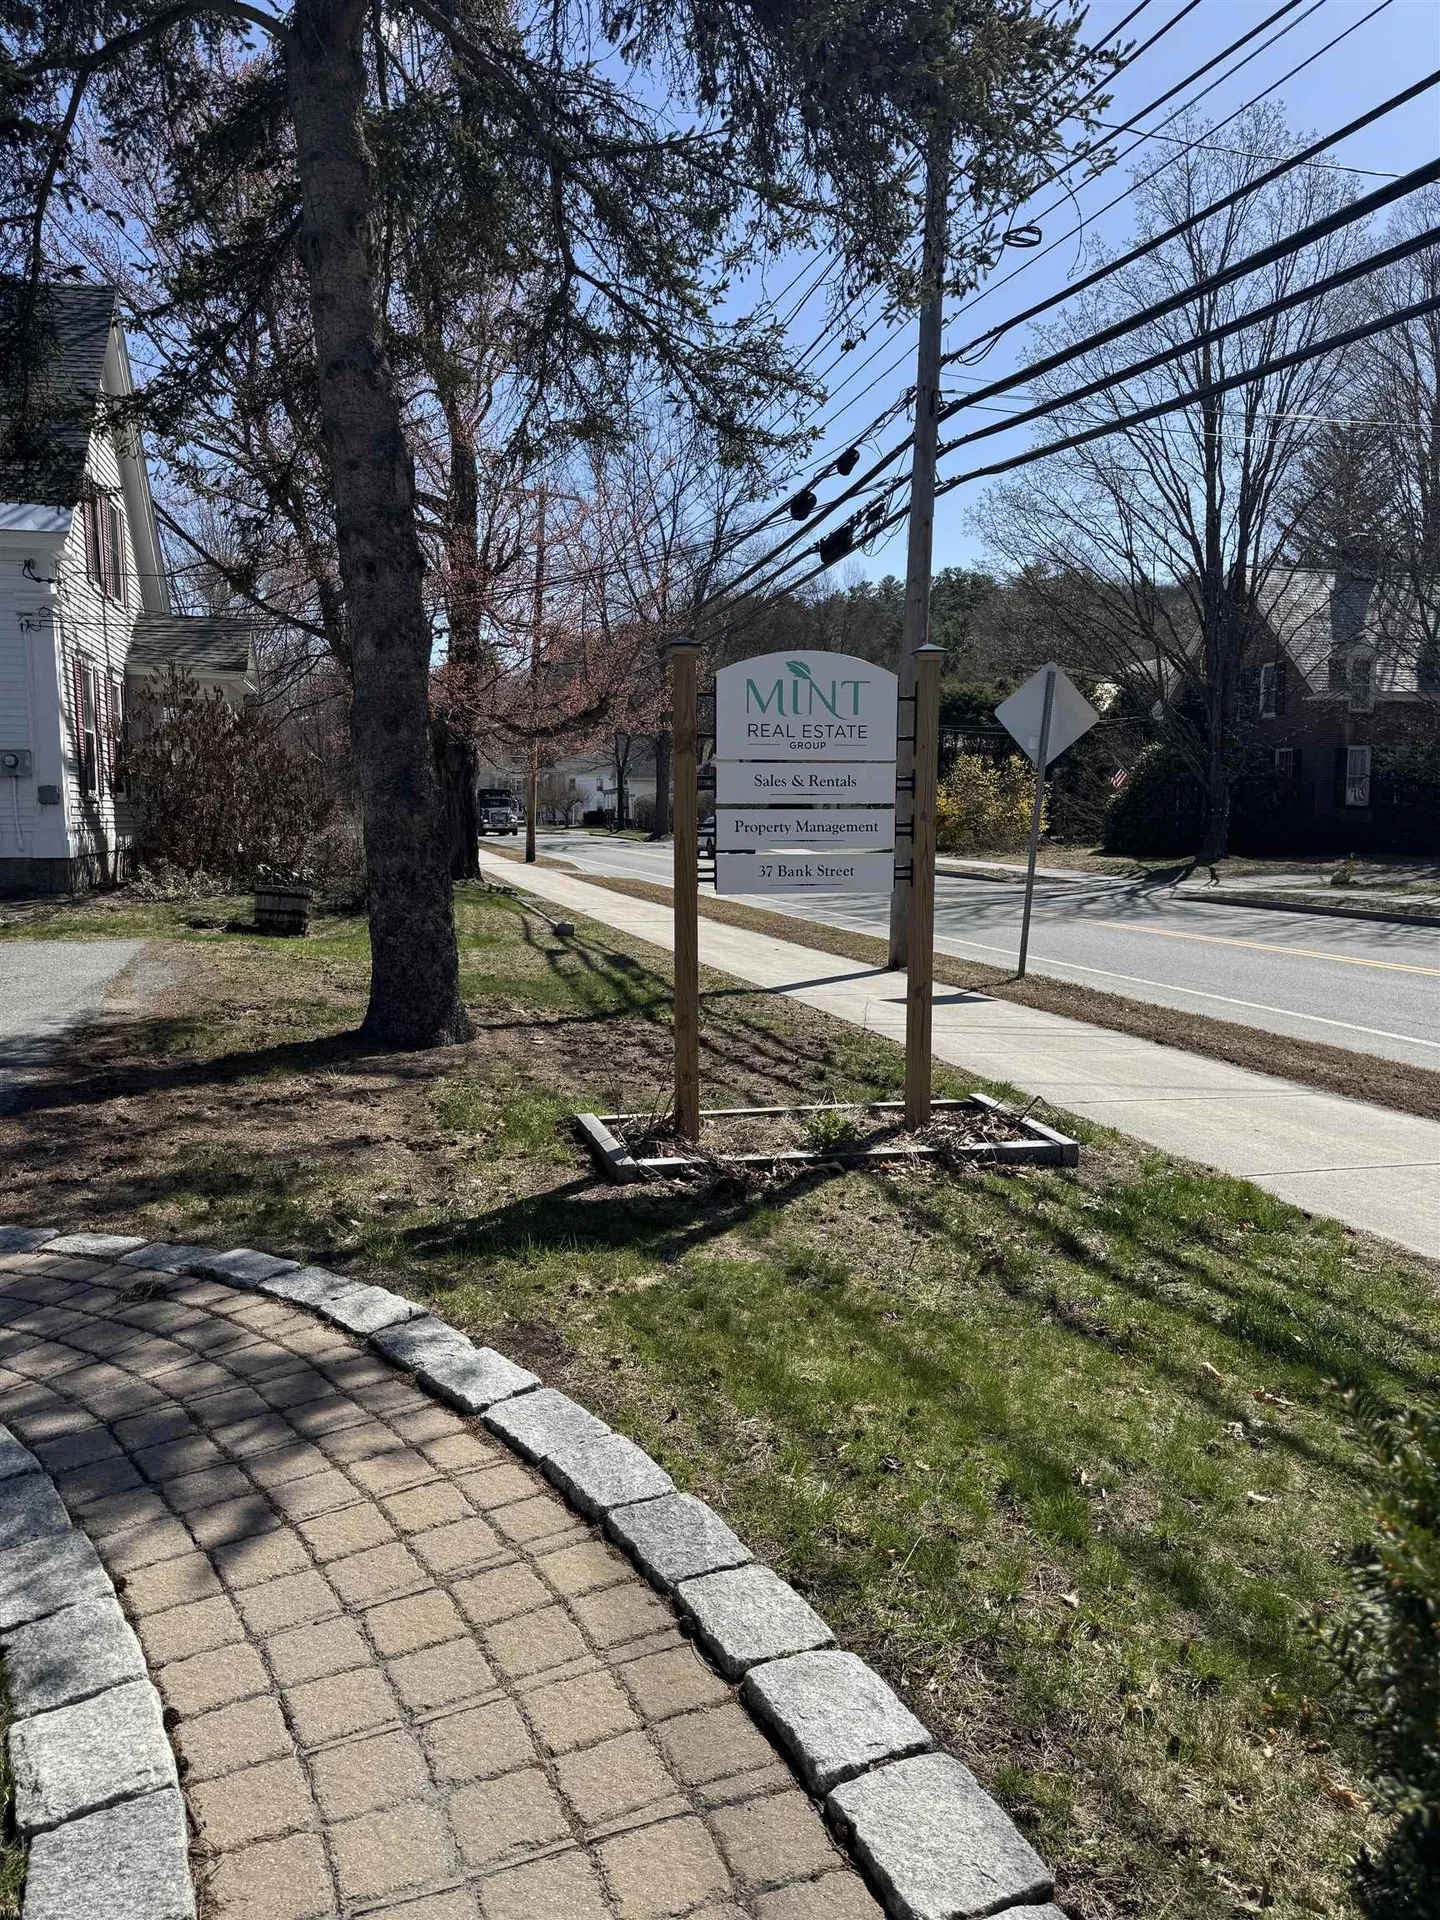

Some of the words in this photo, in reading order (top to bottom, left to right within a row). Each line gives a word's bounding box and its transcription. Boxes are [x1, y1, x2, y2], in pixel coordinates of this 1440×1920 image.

[746, 678, 871, 720] MINT
[747, 723, 795, 738] REAL
[802, 724, 868, 739] ESTATE
[789, 741, 827, 750] GROUP
[754, 774, 787, 788] Sales
[791, 775, 805, 788] &
[809, 774, 857, 788] Rentals
[734, 820, 790, 834] Property
[796, 820, 879, 834] Management
[758, 865, 773, 878] 37
[778, 865, 812, 877] Bank
[816, 865, 854, 877] Street
